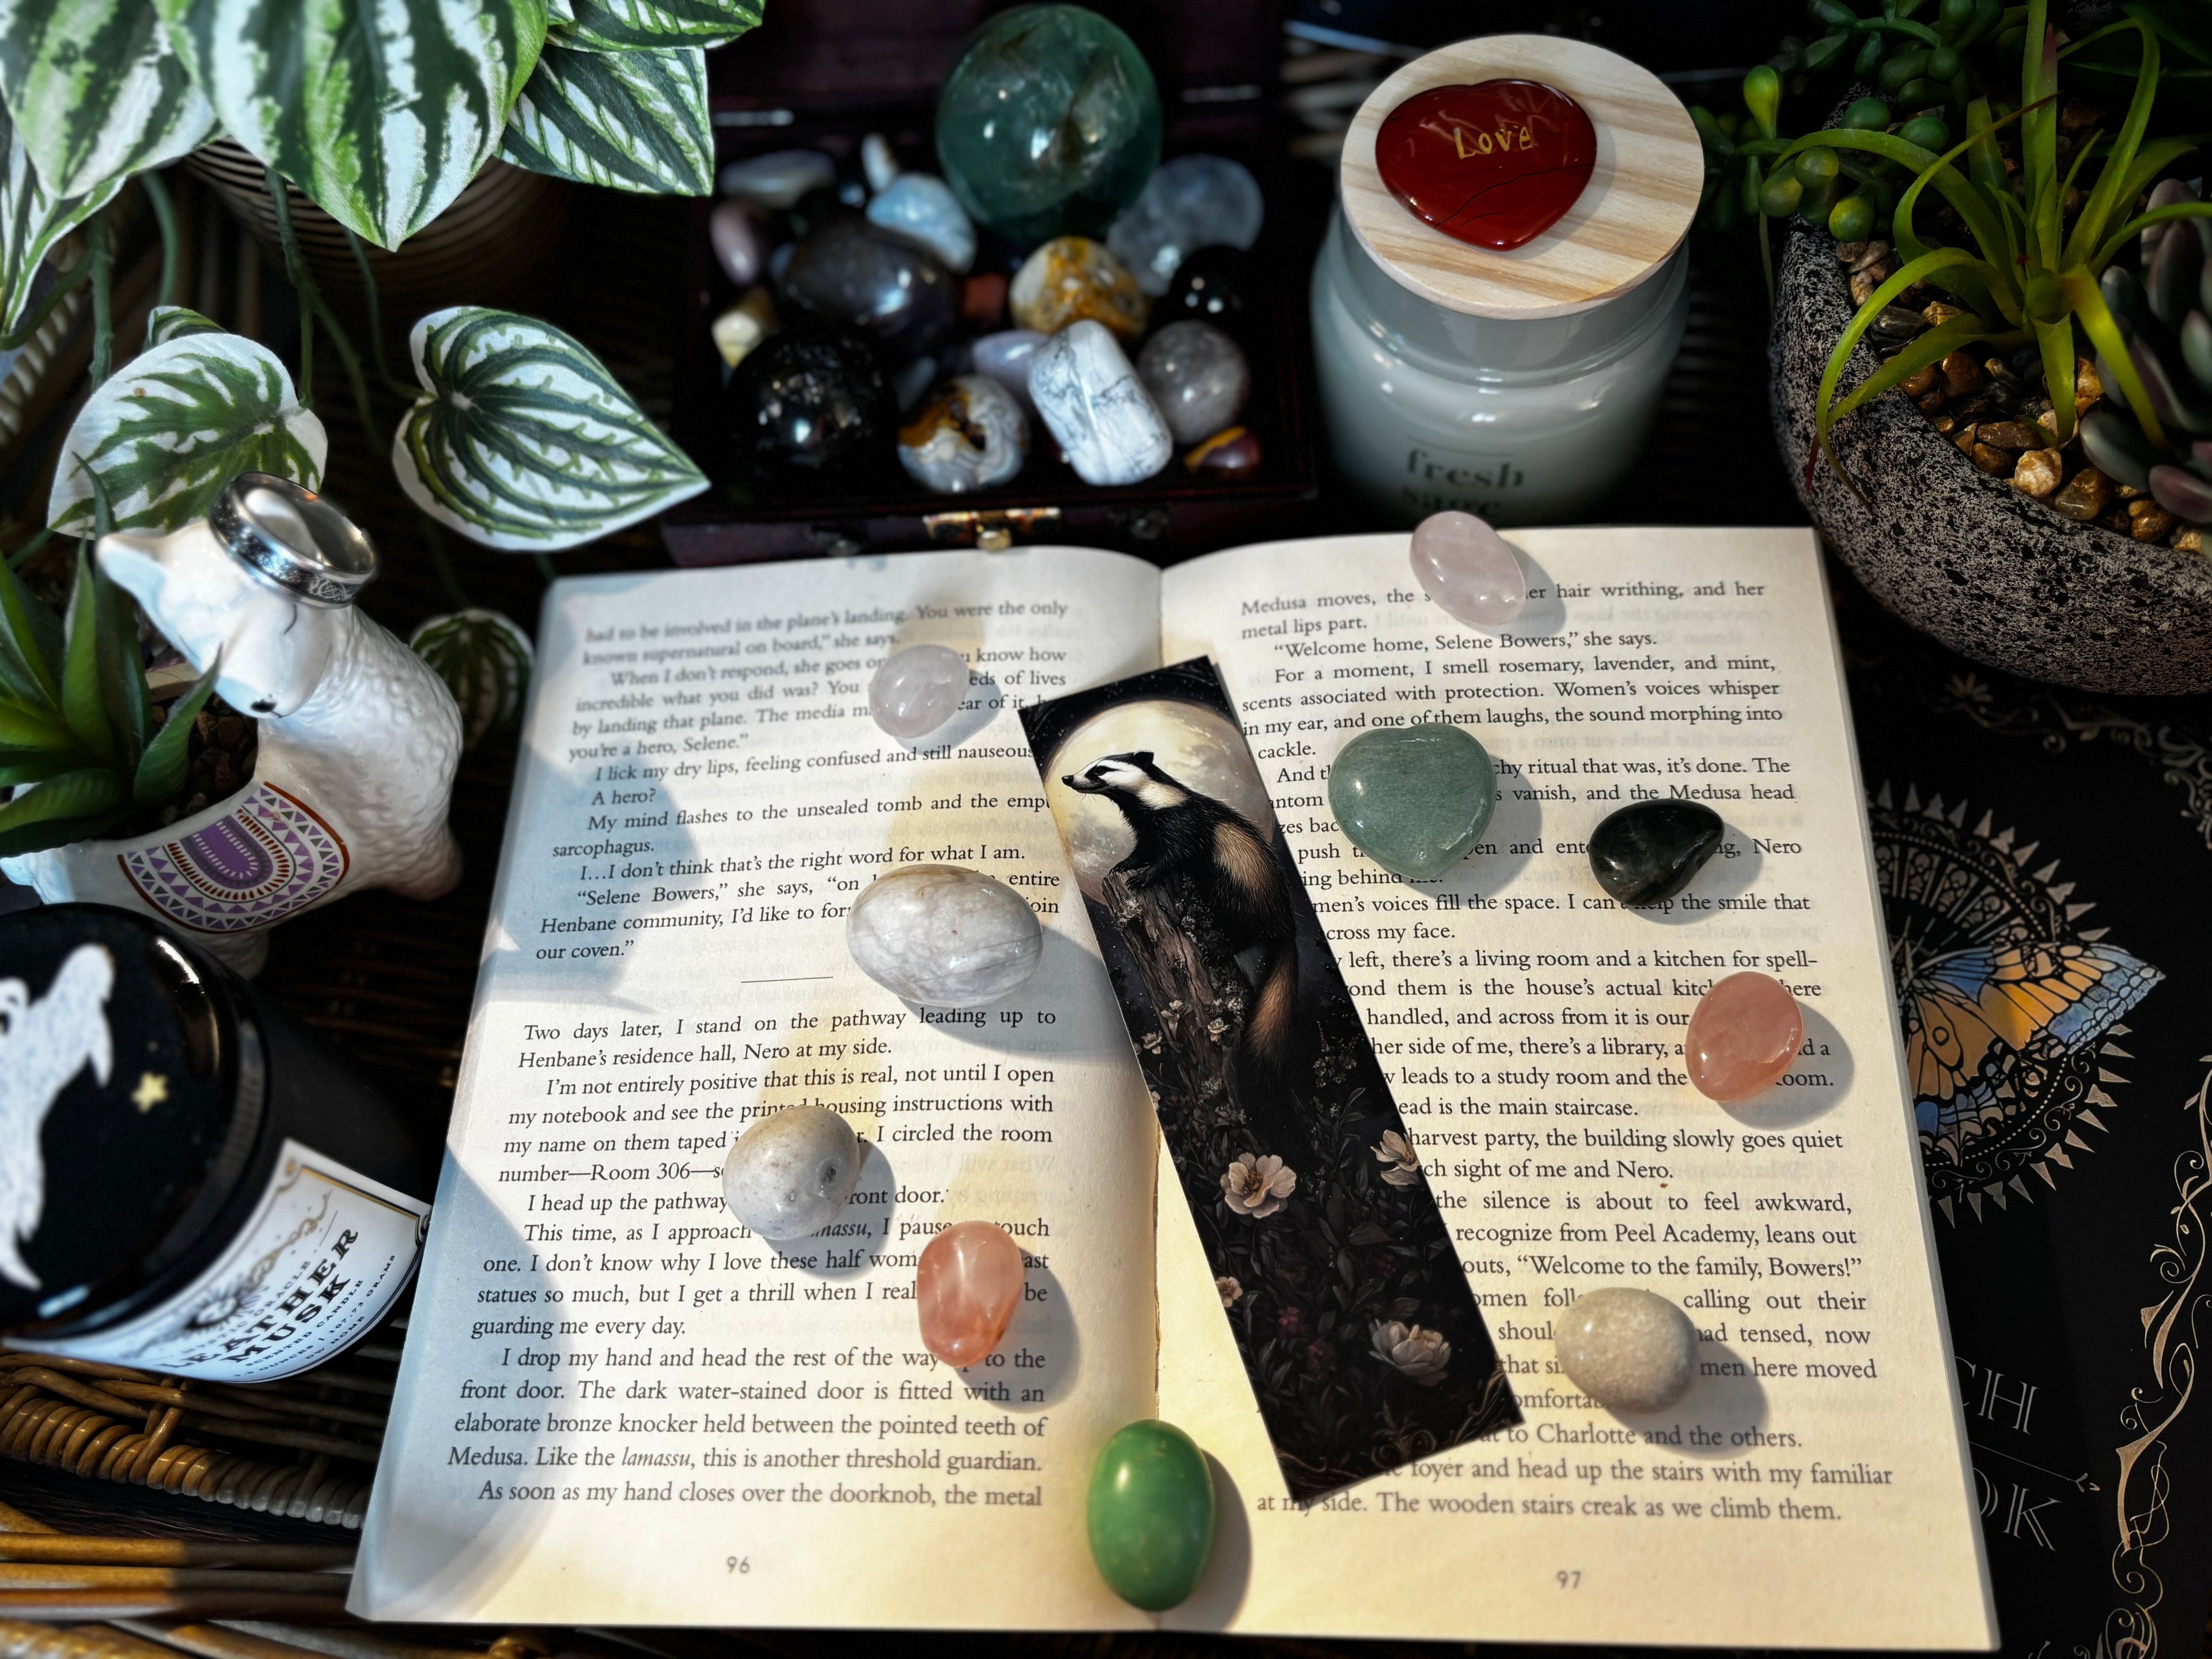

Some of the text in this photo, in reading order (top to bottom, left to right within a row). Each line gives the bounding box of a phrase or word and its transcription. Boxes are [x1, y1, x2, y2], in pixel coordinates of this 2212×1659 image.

[1453, 126, 1533, 160] Love
[1407, 449, 1524, 488] fresh
[1242, 618, 1367, 639] metal lips part.
[1275, 631, 1657, 657] “Welcome home, Selene Bowers,” she says.
[1275, 655, 1775, 683] For a moment, I smell rosemary, lavender, and mint,
[592, 788, 656, 805] A hero?
[588, 793, 998, 833] My mind flashes to the unsealed tomb and the
[621, 862, 664, 878] don’t
[670, 859, 713, 875] think
[721, 855, 762, 872] that’s
[769, 854, 794, 869] the
[801, 851, 842, 871] right
[849, 847, 893, 864] word
[899, 846, 925, 862] for
[930, 845, 974, 860] what
[980, 844, 987, 859] I
[994, 849, 1025, 859] am.
[525, 1007, 1055, 1043] Two days later, I stand on the pathway leading up to
[518, 1037, 891, 1067] Henbane’s residence hall, Nero at my side.
[547, 1063, 1054, 1096] I’m not entirely positive that this is real, not until I open
[1408, 1127, 1843, 1153] harvest party, the building slowly goes quiet
[1456, 1222, 1857, 1248] recognize from Peel Academy, leans out
[1518, 1255, 1861, 1281] “Welcome to the family, Bowers!”
[154, 1229, 358, 1368] LEATHER
[254, 1261, 310, 1316] ORACLE
[220, 1274, 351, 1363] MUSK
[245, 1280, 363, 1366] SCENTED CANDLE
[259, 1345, 314, 1370] OUNCES
[366, 1255, 395, 1297] GRAMS
[306, 1316, 365, 1359] DW HOME
[471, 1316, 685, 1340] guarding me every day.
[460, 1379, 1045, 1402] front door. The dark water-stained door is fitted with an
[454, 1412, 1048, 1440] elaborate bronze knocker held between the pointed teeth of
[447, 1445, 1041, 1475] Medusa. Like the lamassu, this is another threshold guardian.
[1257, 1495, 1275, 1510] at
[1323, 1491, 1368, 1513] side.
[1376, 1491, 1419, 1512] The
[1428, 1493, 1515, 1513] wooden
[1522, 1499, 1574, 1514] stairs
[1582, 1495, 1638, 1516] creak
[1645, 1502, 1664, 1516] as
[1672, 1503, 1702, 1517] we
[1710, 1497, 1771, 1519] climb
[1778, 1498, 1841, 1520] them.
[726, 1555, 751, 1574] 96
[1556, 1570, 1582, 1589] 97
